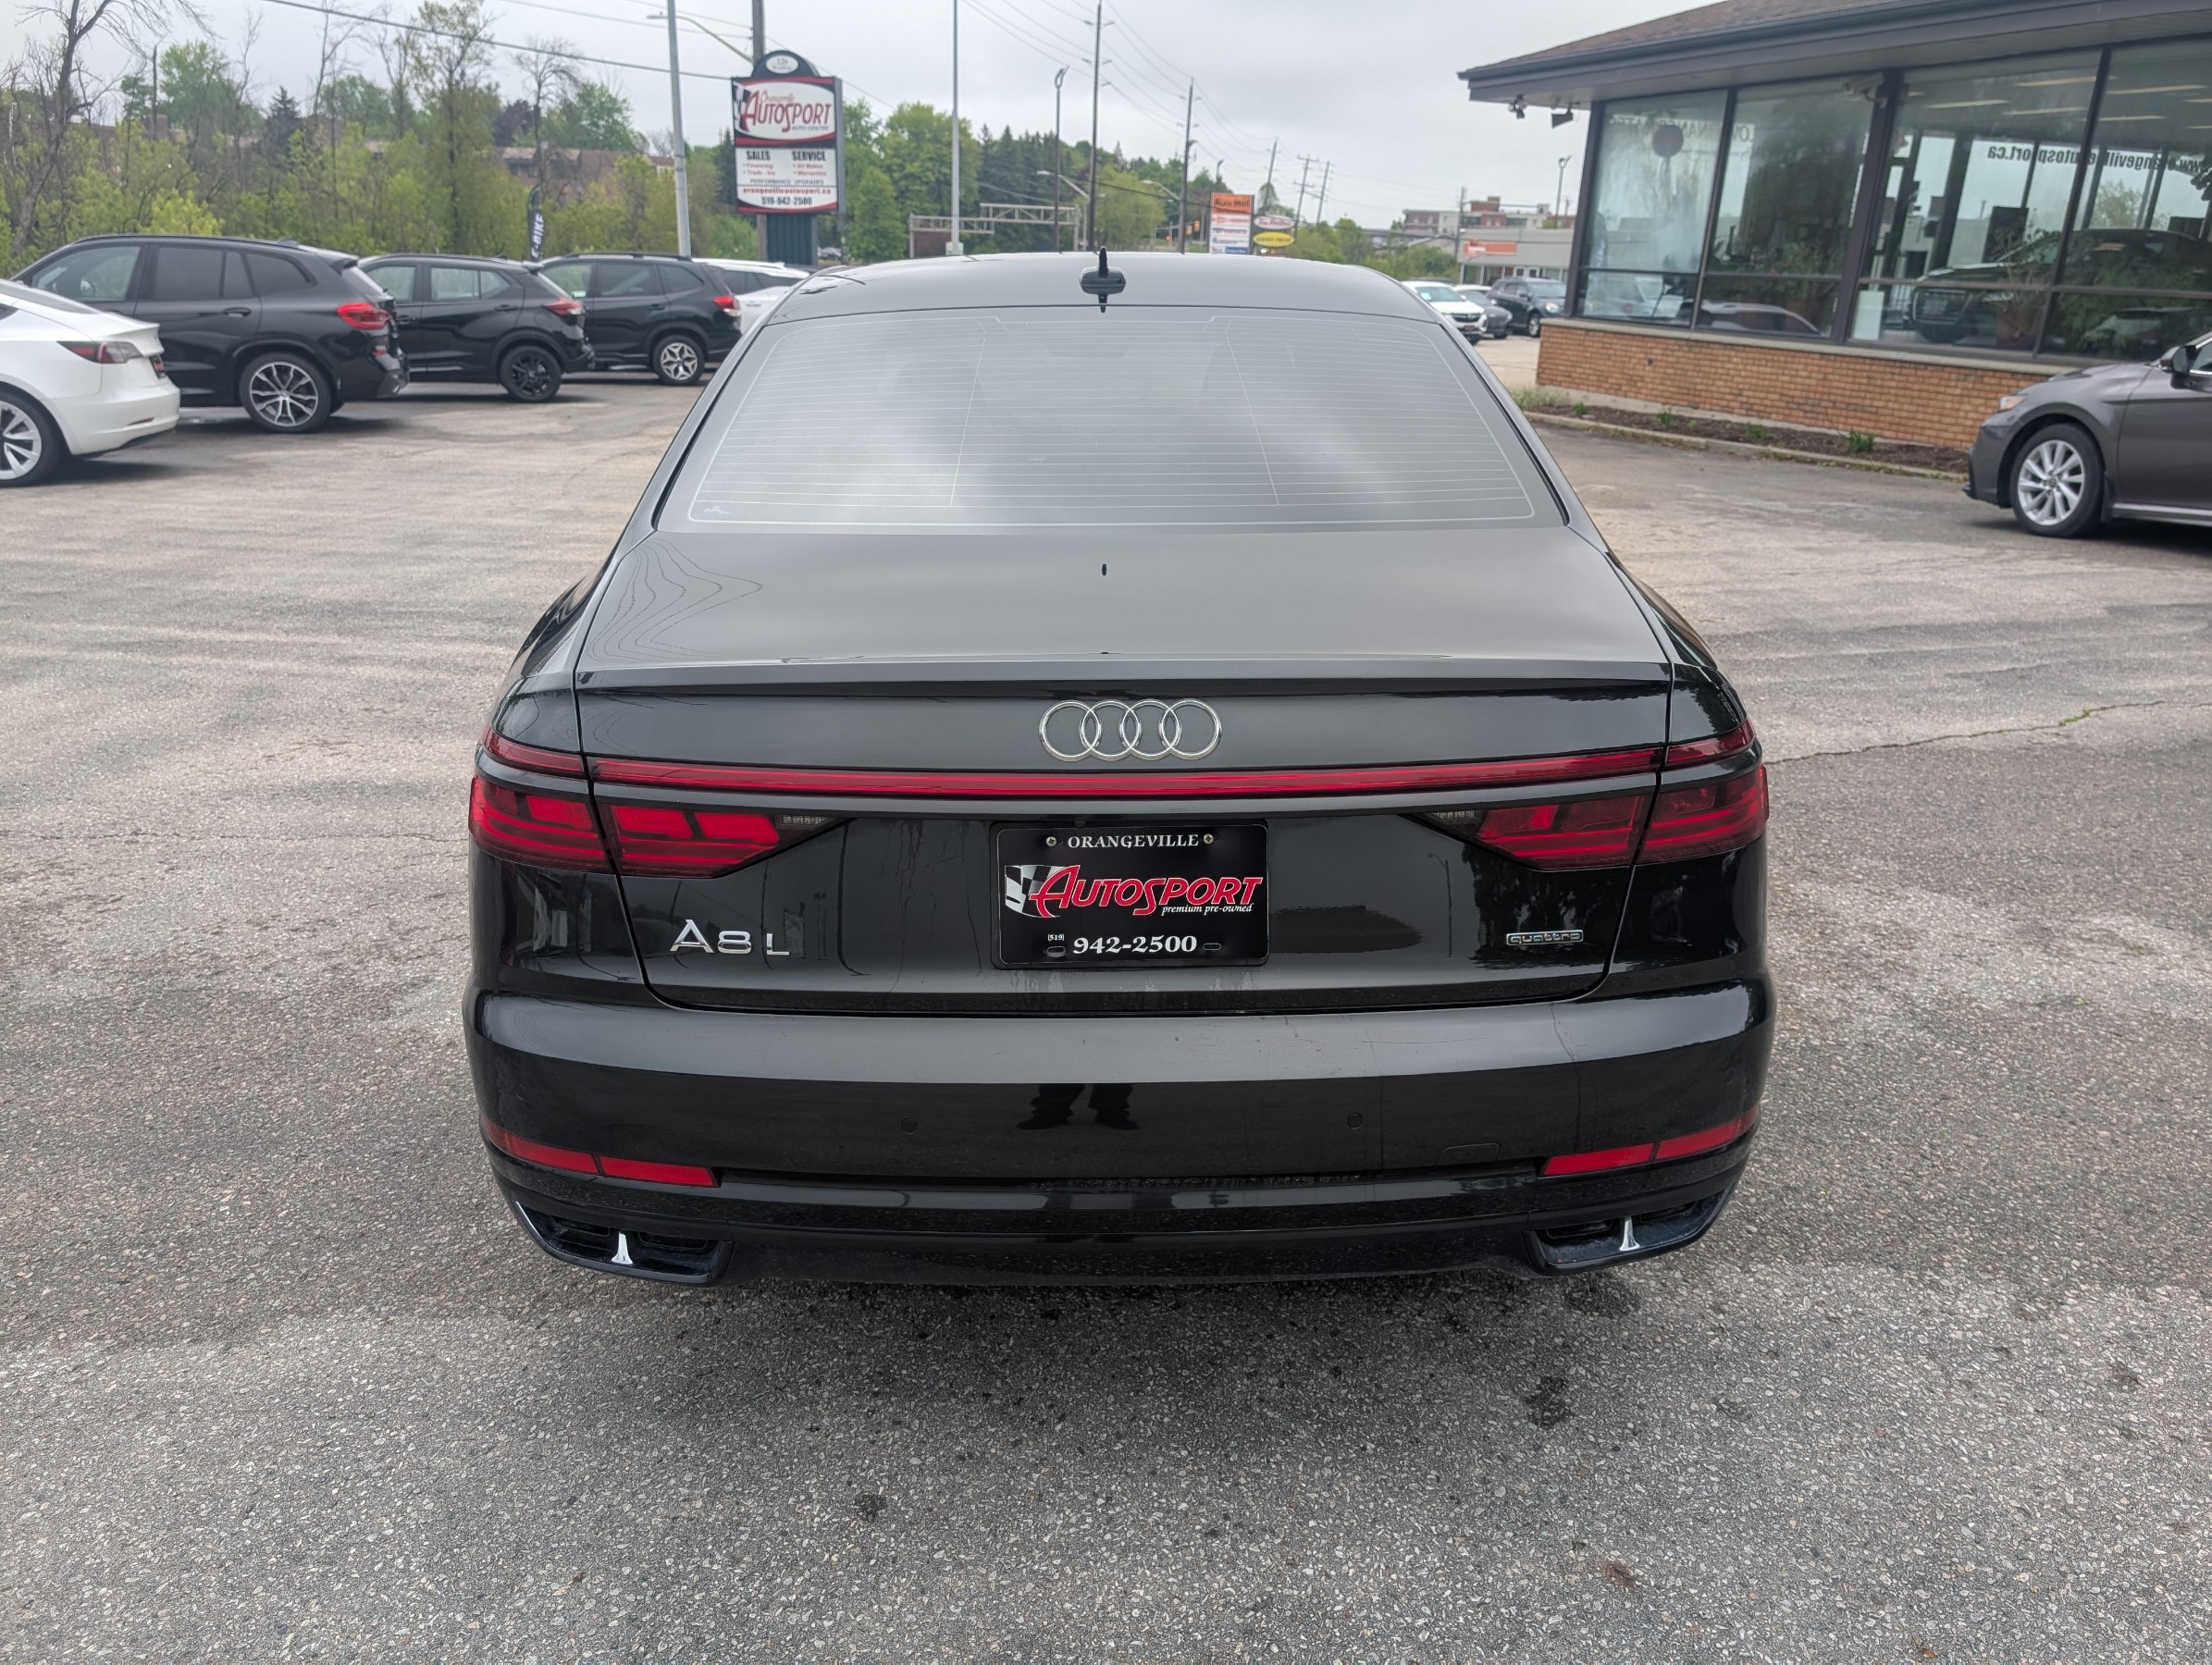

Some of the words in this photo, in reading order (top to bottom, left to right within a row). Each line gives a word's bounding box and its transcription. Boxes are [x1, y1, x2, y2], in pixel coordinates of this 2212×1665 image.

[742, 90, 832, 133] AUTOSPORT
[746, 151, 771, 161] SALES
[792, 151, 826, 161] SERVICE
[531, 213, 545, 258] E-BIKE
[1067, 833, 1200, 849] ORANGEVILLE
[1029, 864, 1264, 918] AUTOSPORT
[1161, 904, 1204, 917] premium
[1204, 903, 1254, 916] pre-owned
[670, 919, 752, 955] A8
[766, 932, 790, 956] L
[1047, 933, 1065, 942] (519)
[1073, 934, 1197, 955] 942-2500
[1510, 932, 1581, 944] quattro
